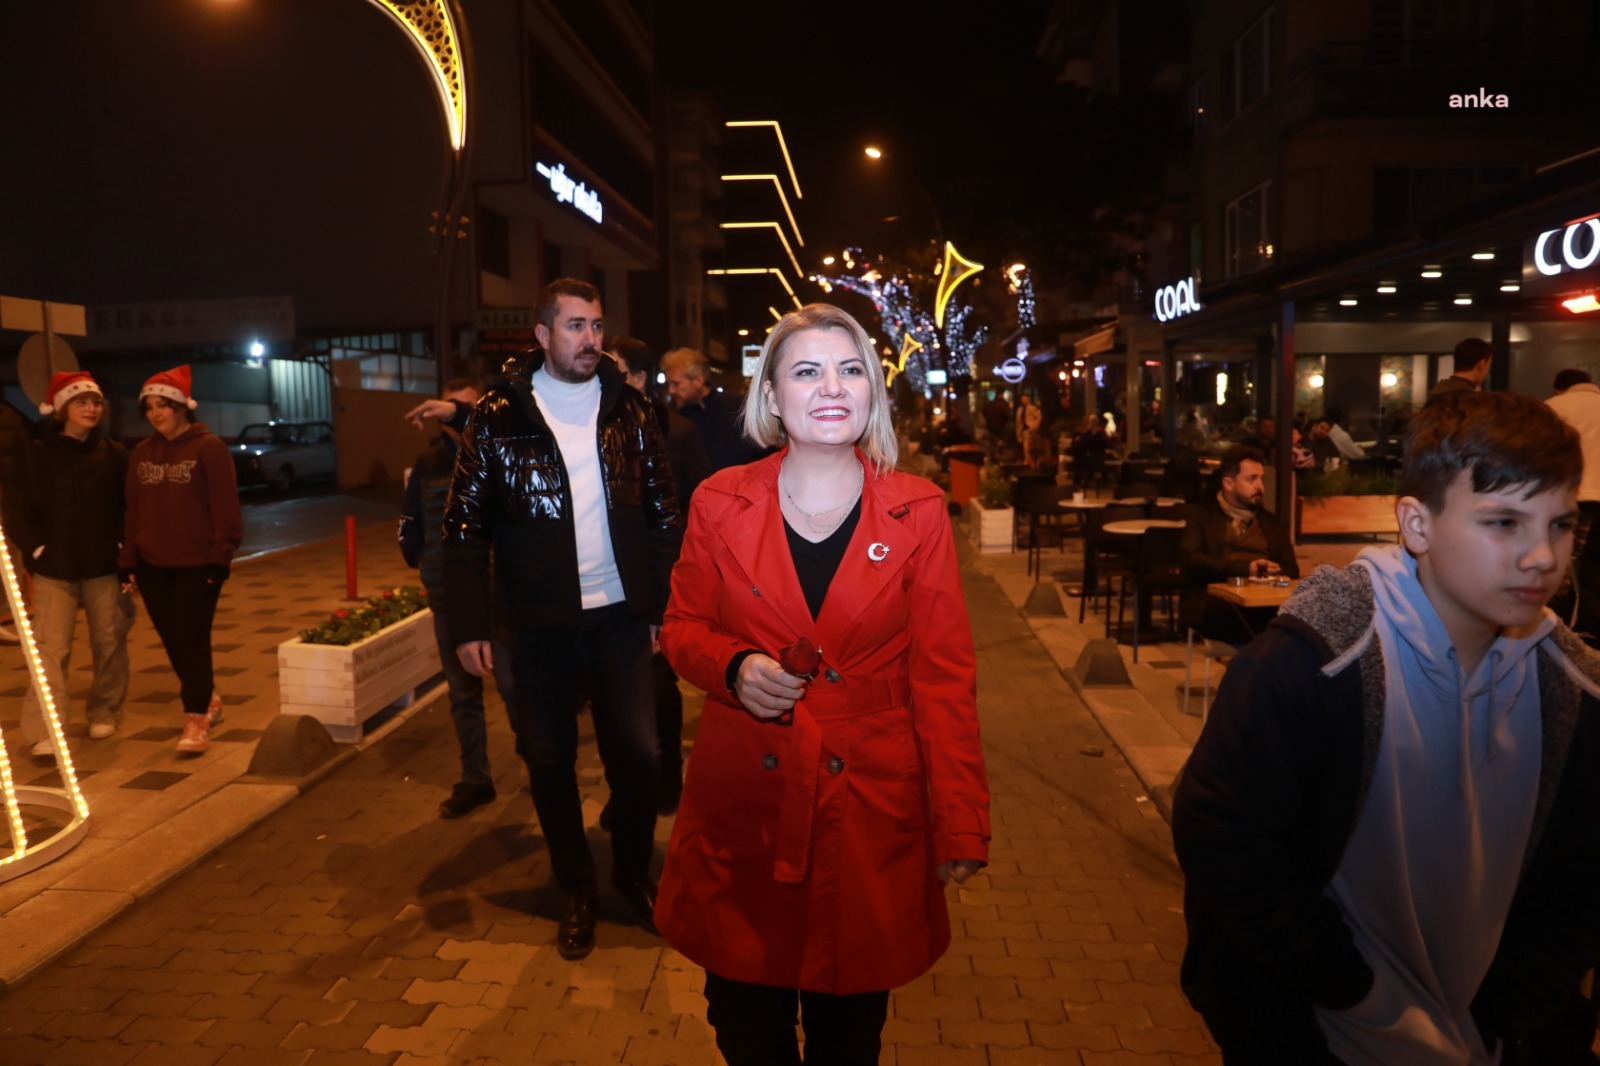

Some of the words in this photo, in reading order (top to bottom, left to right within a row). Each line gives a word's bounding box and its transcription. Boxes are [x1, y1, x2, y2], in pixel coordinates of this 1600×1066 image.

[1155, 276, 1201, 322] COAL
[87, 304, 199, 331] ERKEZ
[481, 313, 529, 327] MERKE
